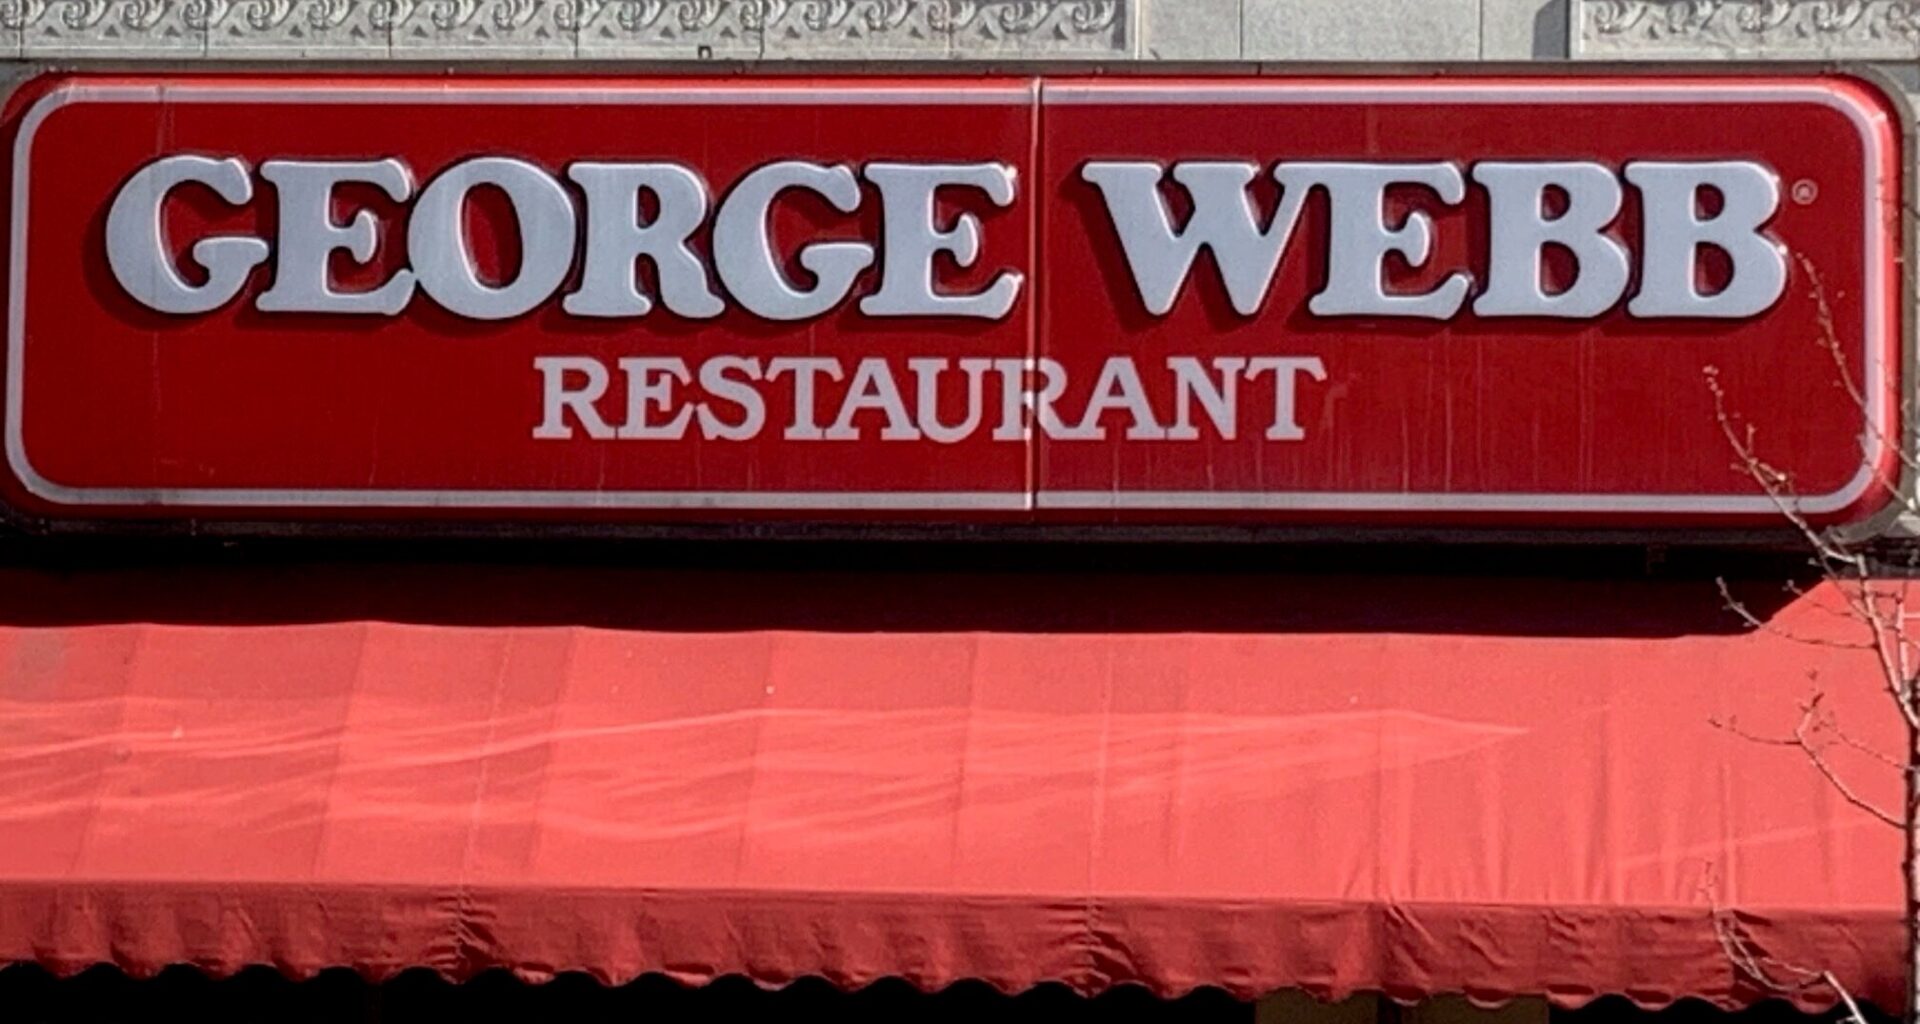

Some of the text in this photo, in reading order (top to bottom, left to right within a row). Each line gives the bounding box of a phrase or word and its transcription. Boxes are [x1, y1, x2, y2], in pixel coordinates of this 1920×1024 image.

[106, 155, 1788, 320] GEORGE WEBB
[533, 356, 1327, 442] RESTAURANT
